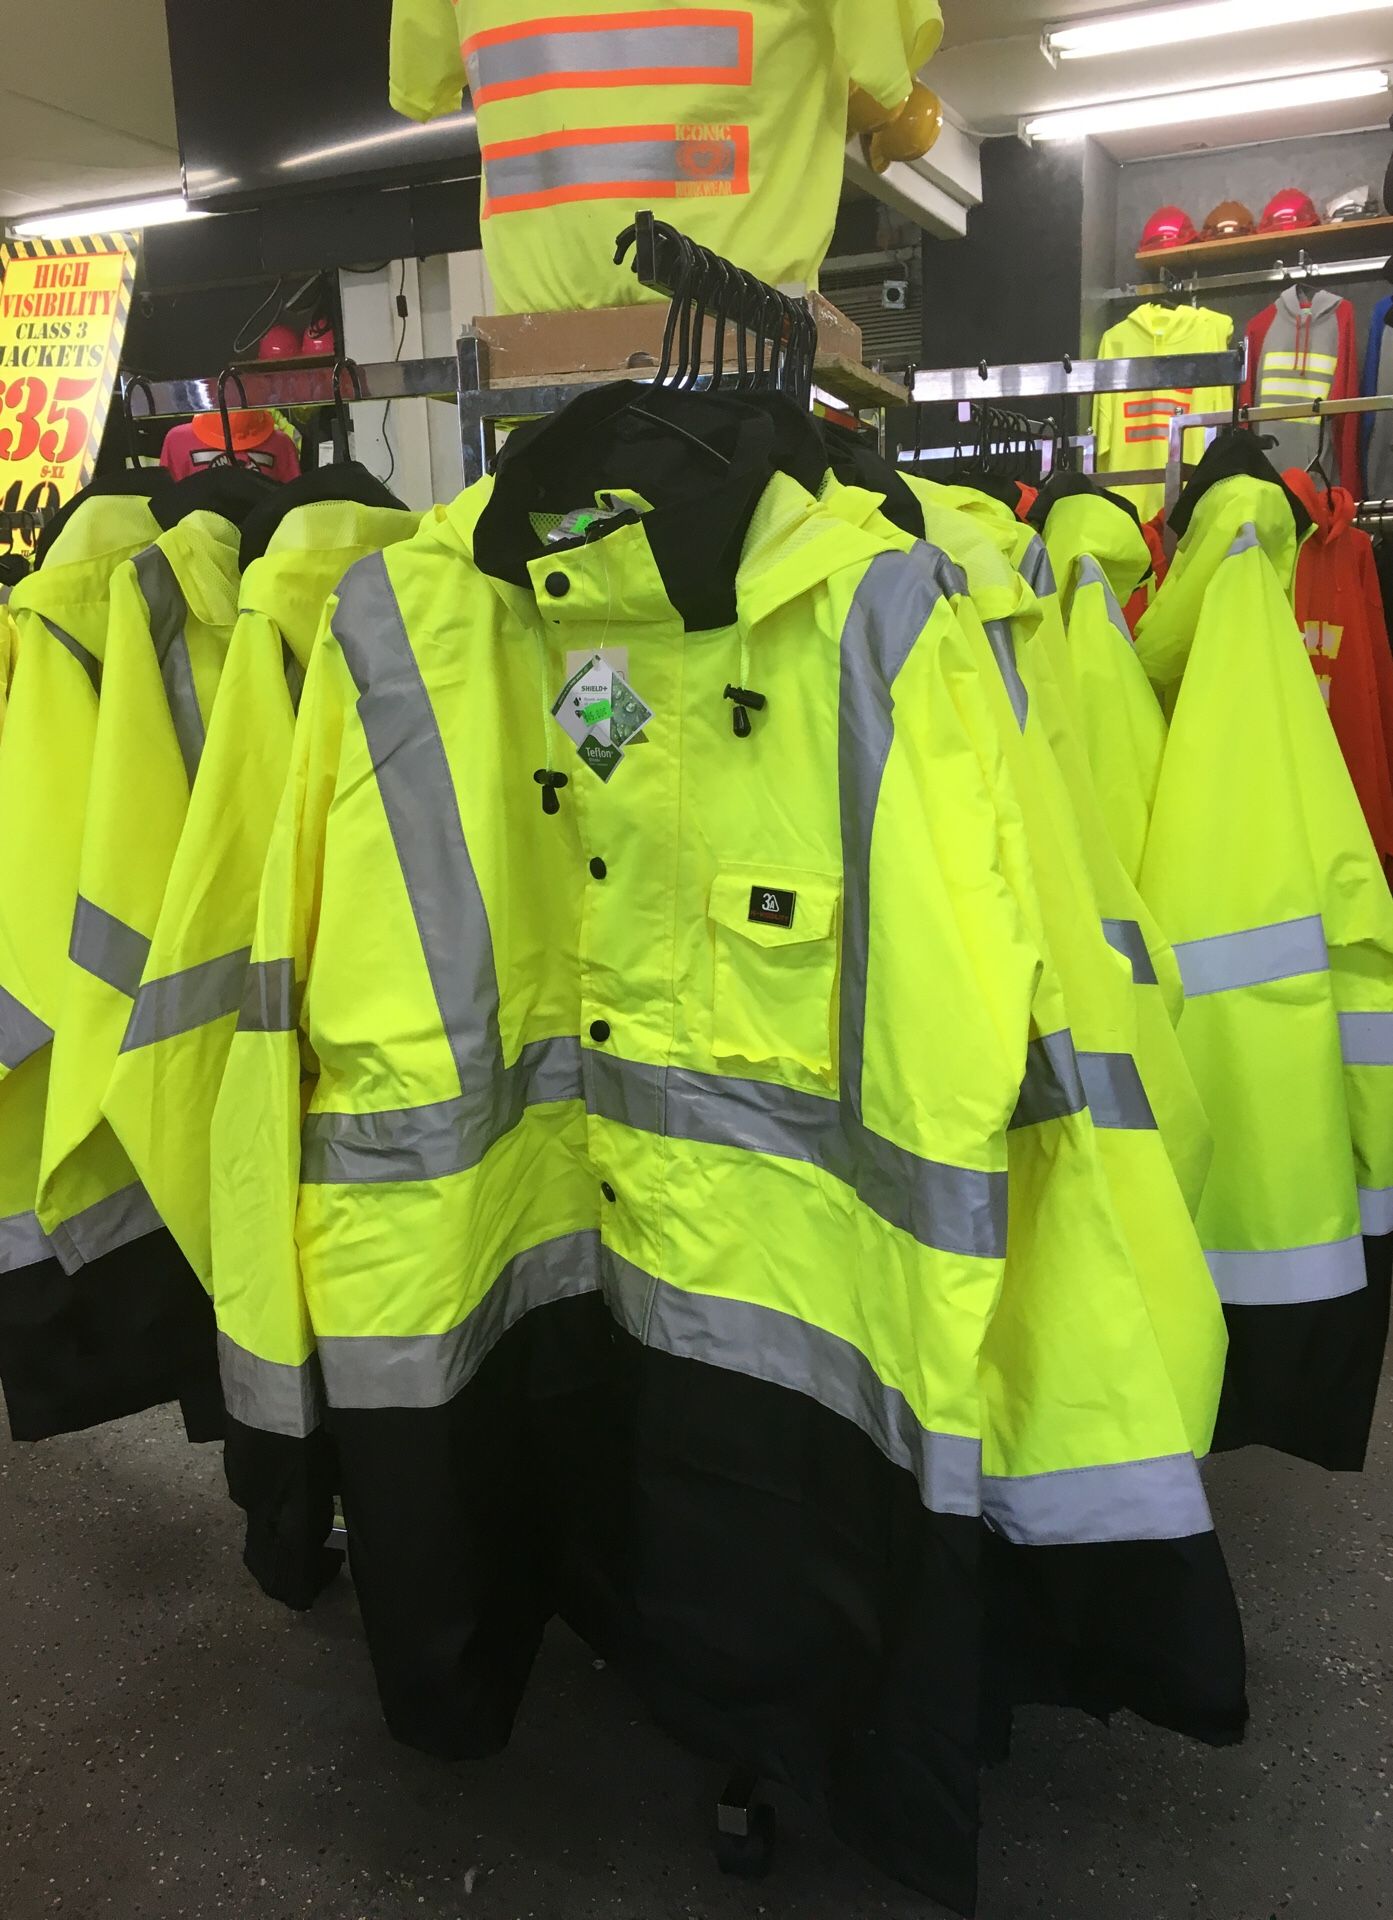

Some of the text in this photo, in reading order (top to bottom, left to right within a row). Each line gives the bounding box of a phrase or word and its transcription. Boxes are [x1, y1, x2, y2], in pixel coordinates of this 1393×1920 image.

[33, 262, 90, 289] HIGH
[3, 290, 117, 318] VISIBILITY
[16, 321, 88, 340] CLASS 3
[40, 465, 65, 478] S-XL
